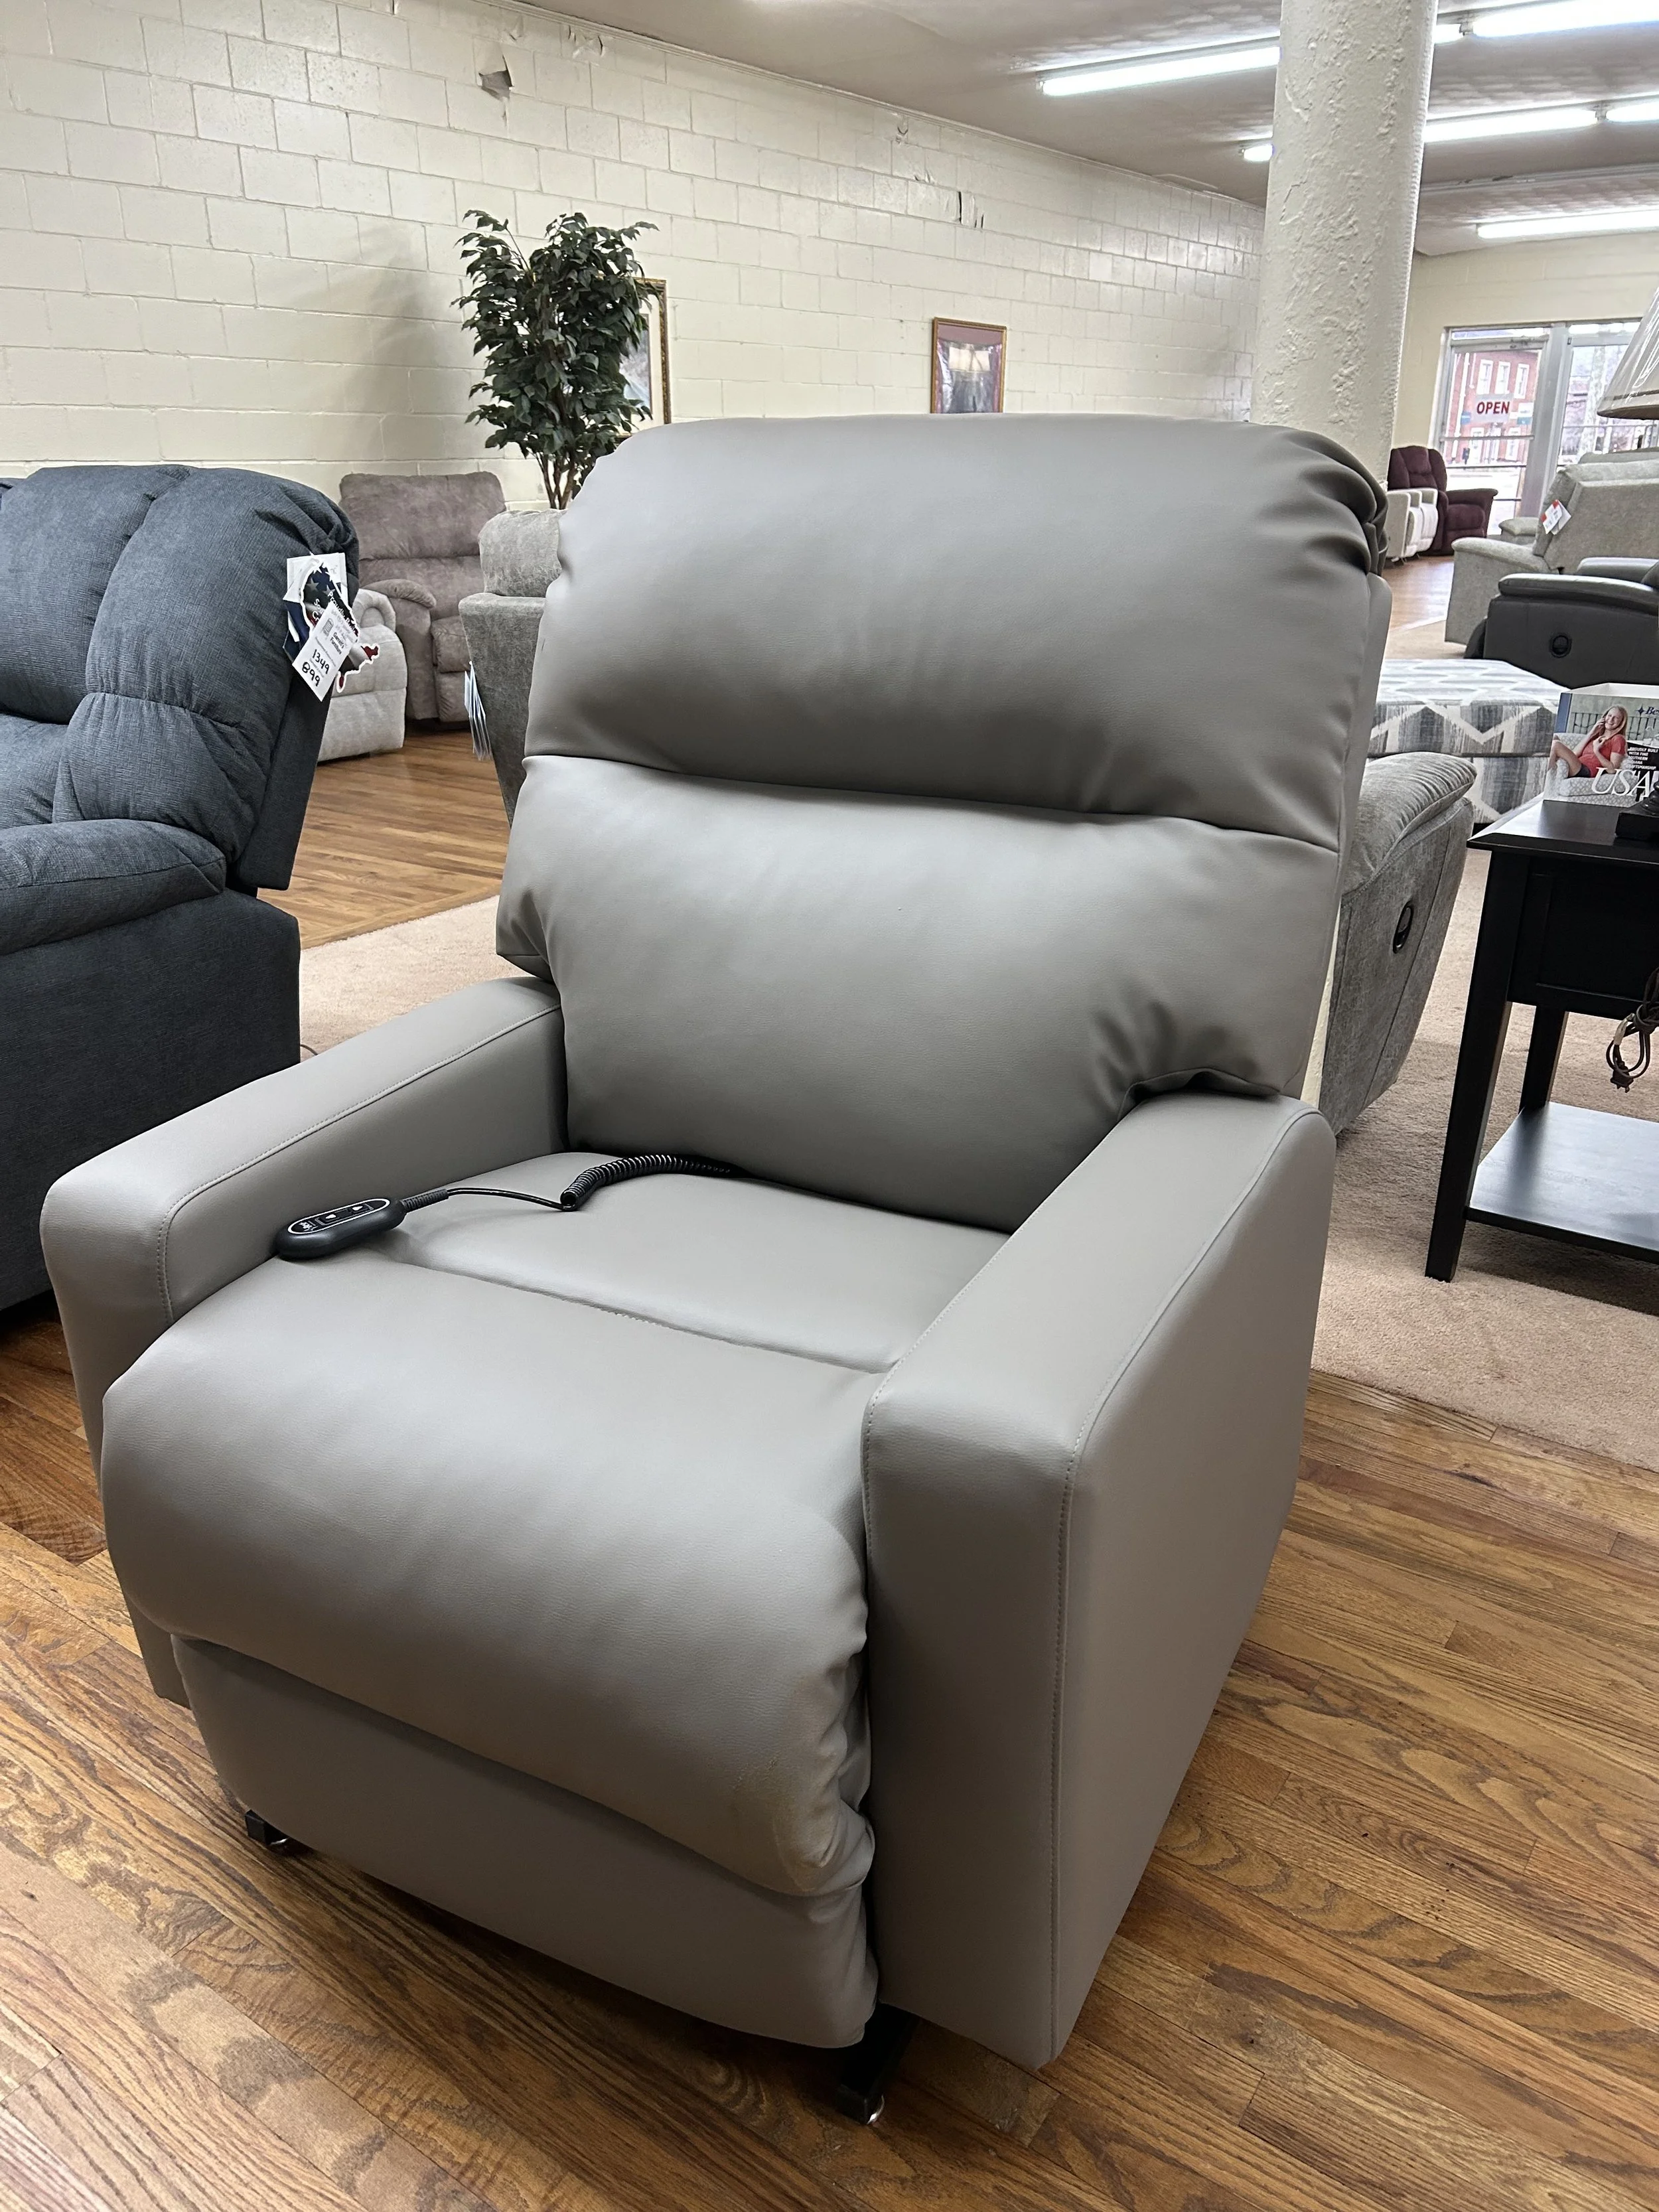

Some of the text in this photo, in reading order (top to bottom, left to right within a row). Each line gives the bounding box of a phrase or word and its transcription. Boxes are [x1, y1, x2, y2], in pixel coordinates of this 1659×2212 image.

[1477, 401, 1510, 414] OPEN
[330, 637, 342, 654] Furniture
[312, 649, 330, 675] 1349
[302, 662, 320, 687] 899
[1646, 706, 1659, 715] Be
[1591, 767, 1650, 798] USA
